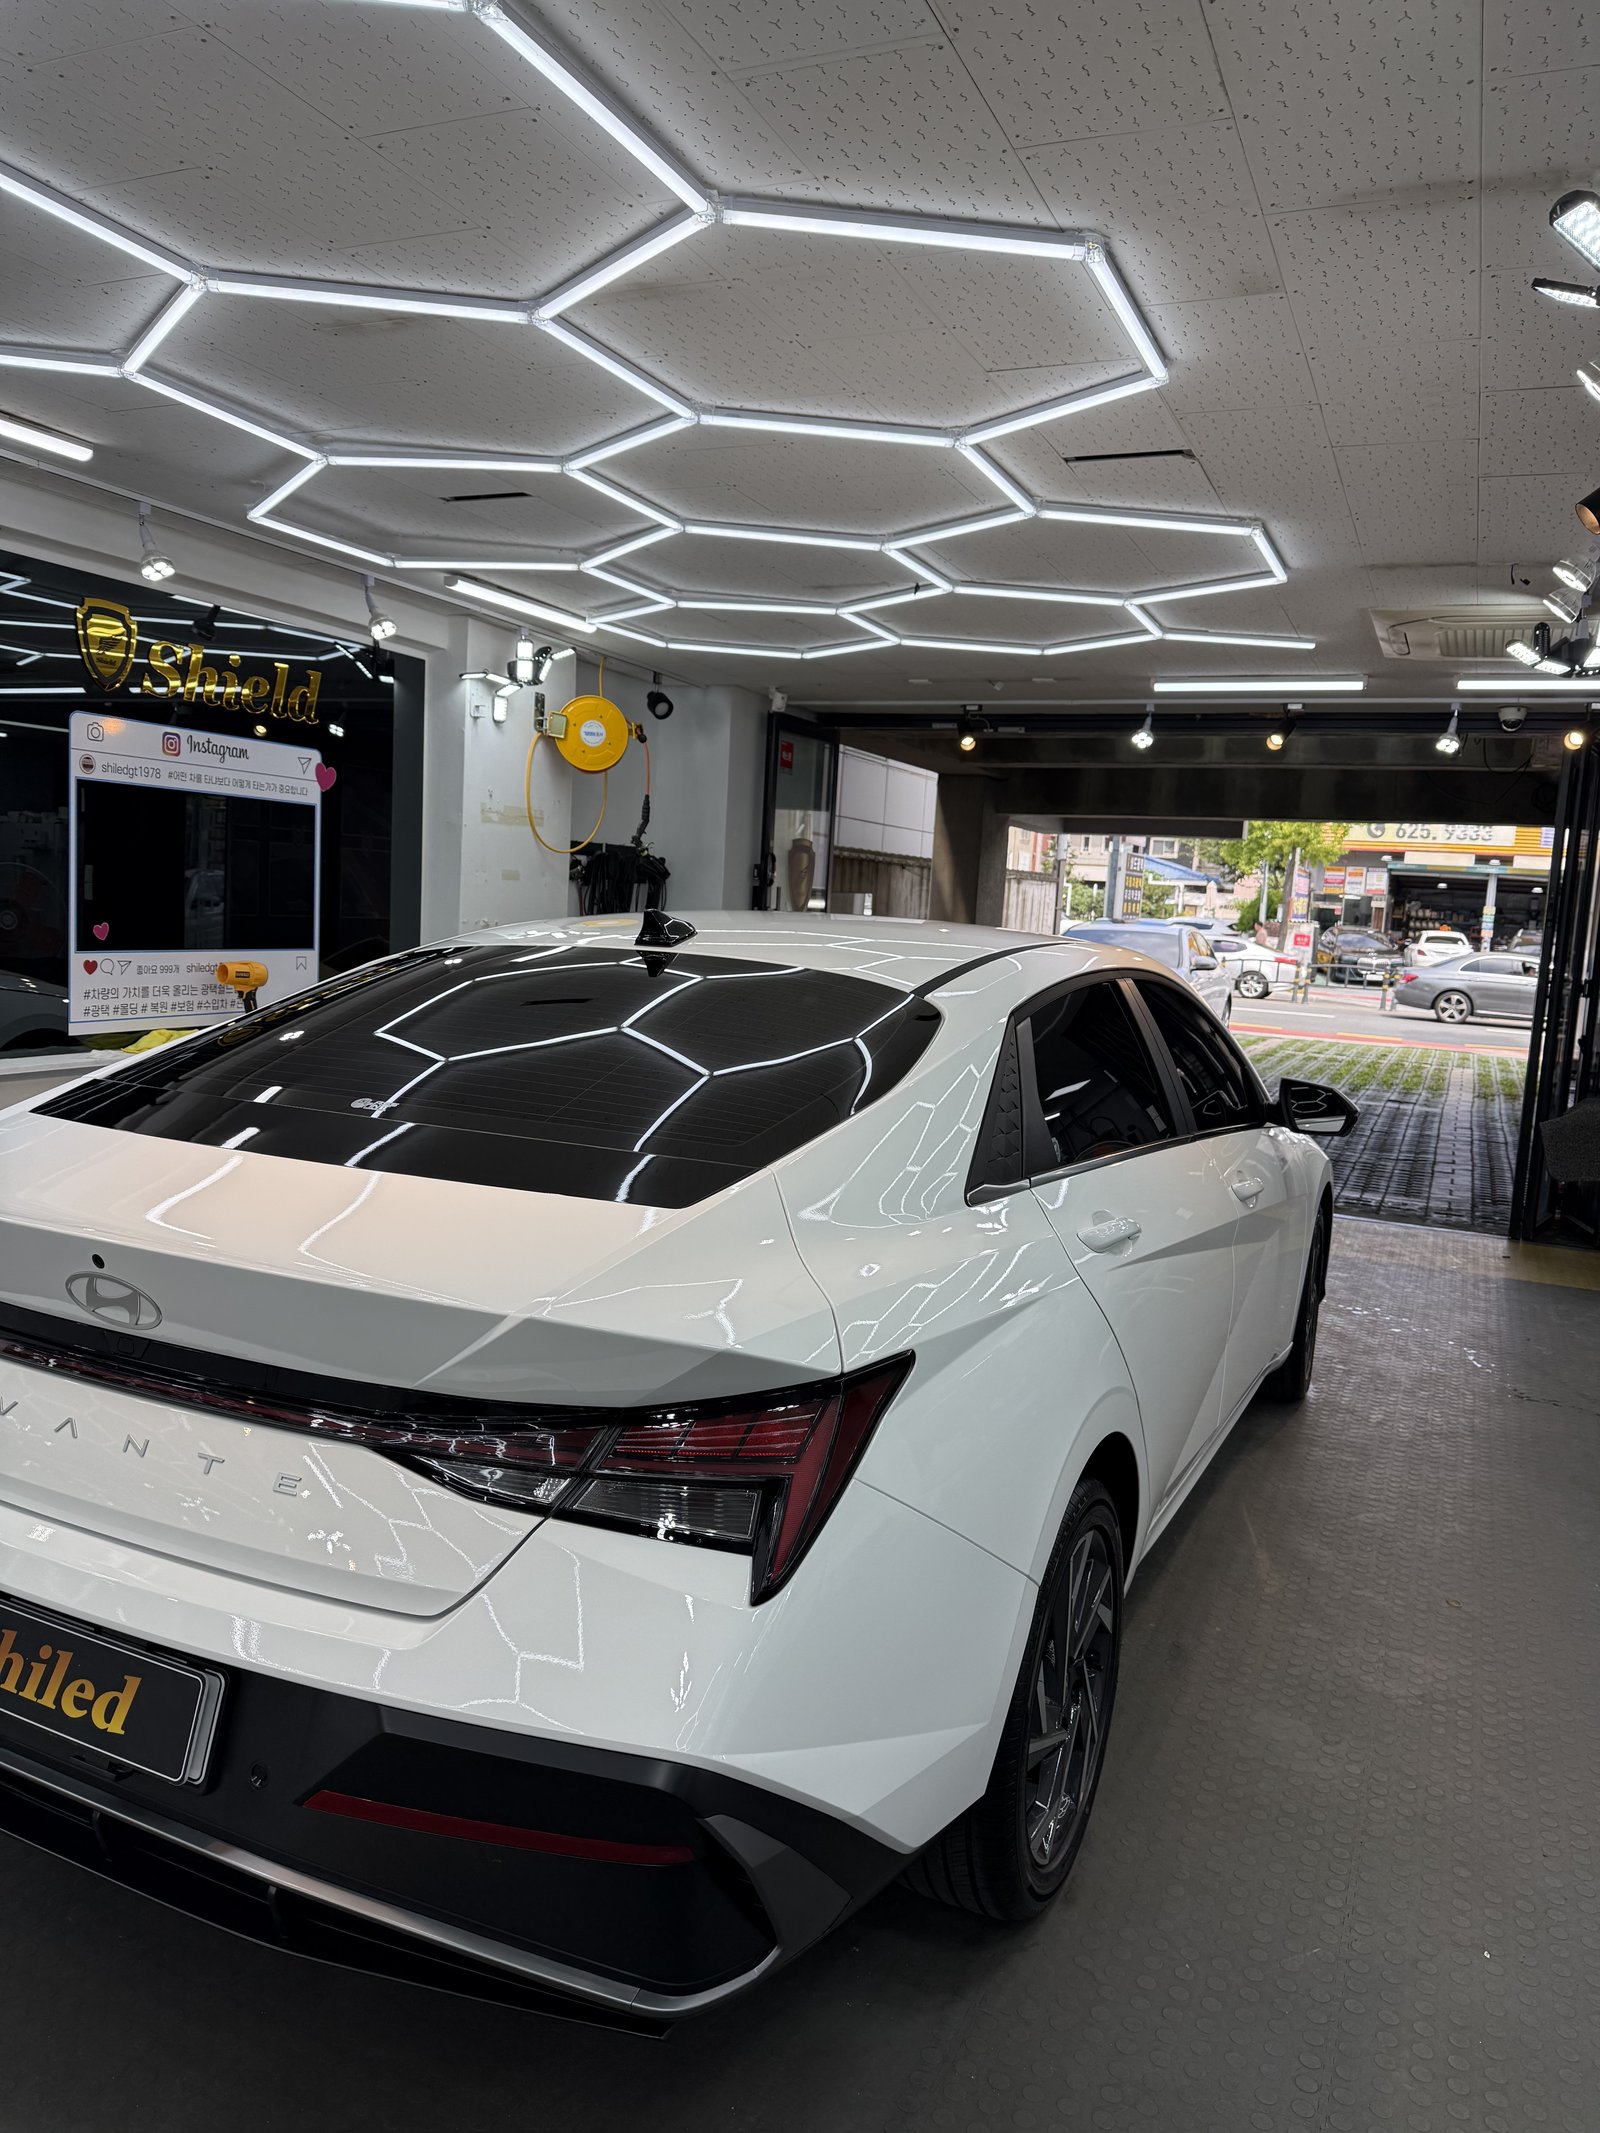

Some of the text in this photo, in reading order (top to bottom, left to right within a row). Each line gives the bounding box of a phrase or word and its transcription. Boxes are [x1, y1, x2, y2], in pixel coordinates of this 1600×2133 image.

[141, 640, 322, 725] Shield
[187, 735, 249, 764] Instagram
[101, 762, 161, 779] shiledgt1978
[168, 770, 187, 782] #어떤
[189, 772, 203, 784] 차를
[232, 777, 251, 789] 어떻게
[279, 784, 309, 796] 중요합니다
[136, 964, 158, 975] 좋아요
[159, 964, 180, 974] 999개
[83, 987, 119, 1000] #차량의
[122, 985, 150, 999] 가치를
[152, 984, 170, 998] 더욱
[173, 984, 198, 997] 올리는
[83, 1004, 109, 1018] #광택
[113, 1002, 138, 1016] #몰딩
[150, 1001, 168, 1014] 복원
[171, 1000, 194, 1012] #보험
[197, 998, 228, 1011] #수입차
